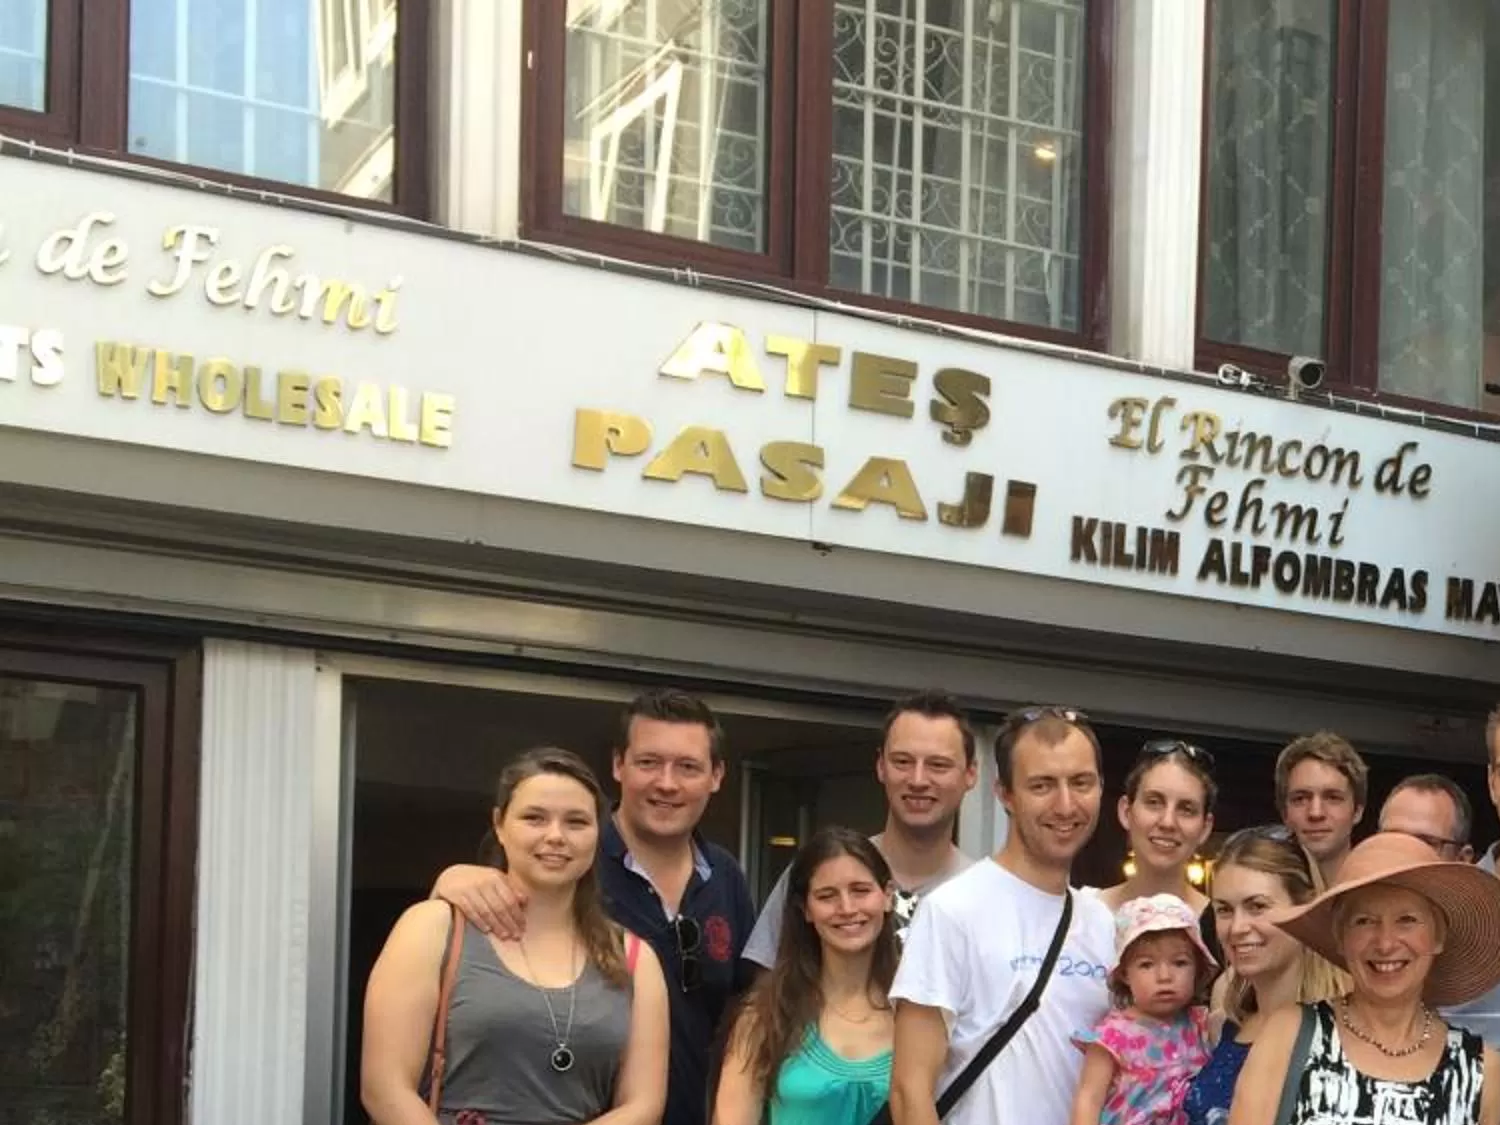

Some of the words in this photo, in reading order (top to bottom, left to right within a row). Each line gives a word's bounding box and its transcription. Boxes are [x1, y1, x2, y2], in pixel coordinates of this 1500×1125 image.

[36, 211, 128, 285] de
[146, 223, 404, 334] Fehmi
[95, 340, 457, 449] WHOLESALE
[657, 320, 991, 446] ATEŞ
[571, 407, 1037, 539] PASAJI
[1107, 396, 1177, 454] El
[1373, 441, 1434, 499] de
[1165, 464, 1350, 548] Fehmi
[1069, 515, 1181, 577] KILIM
[1196, 538, 1430, 614] ALFOMBRAS
